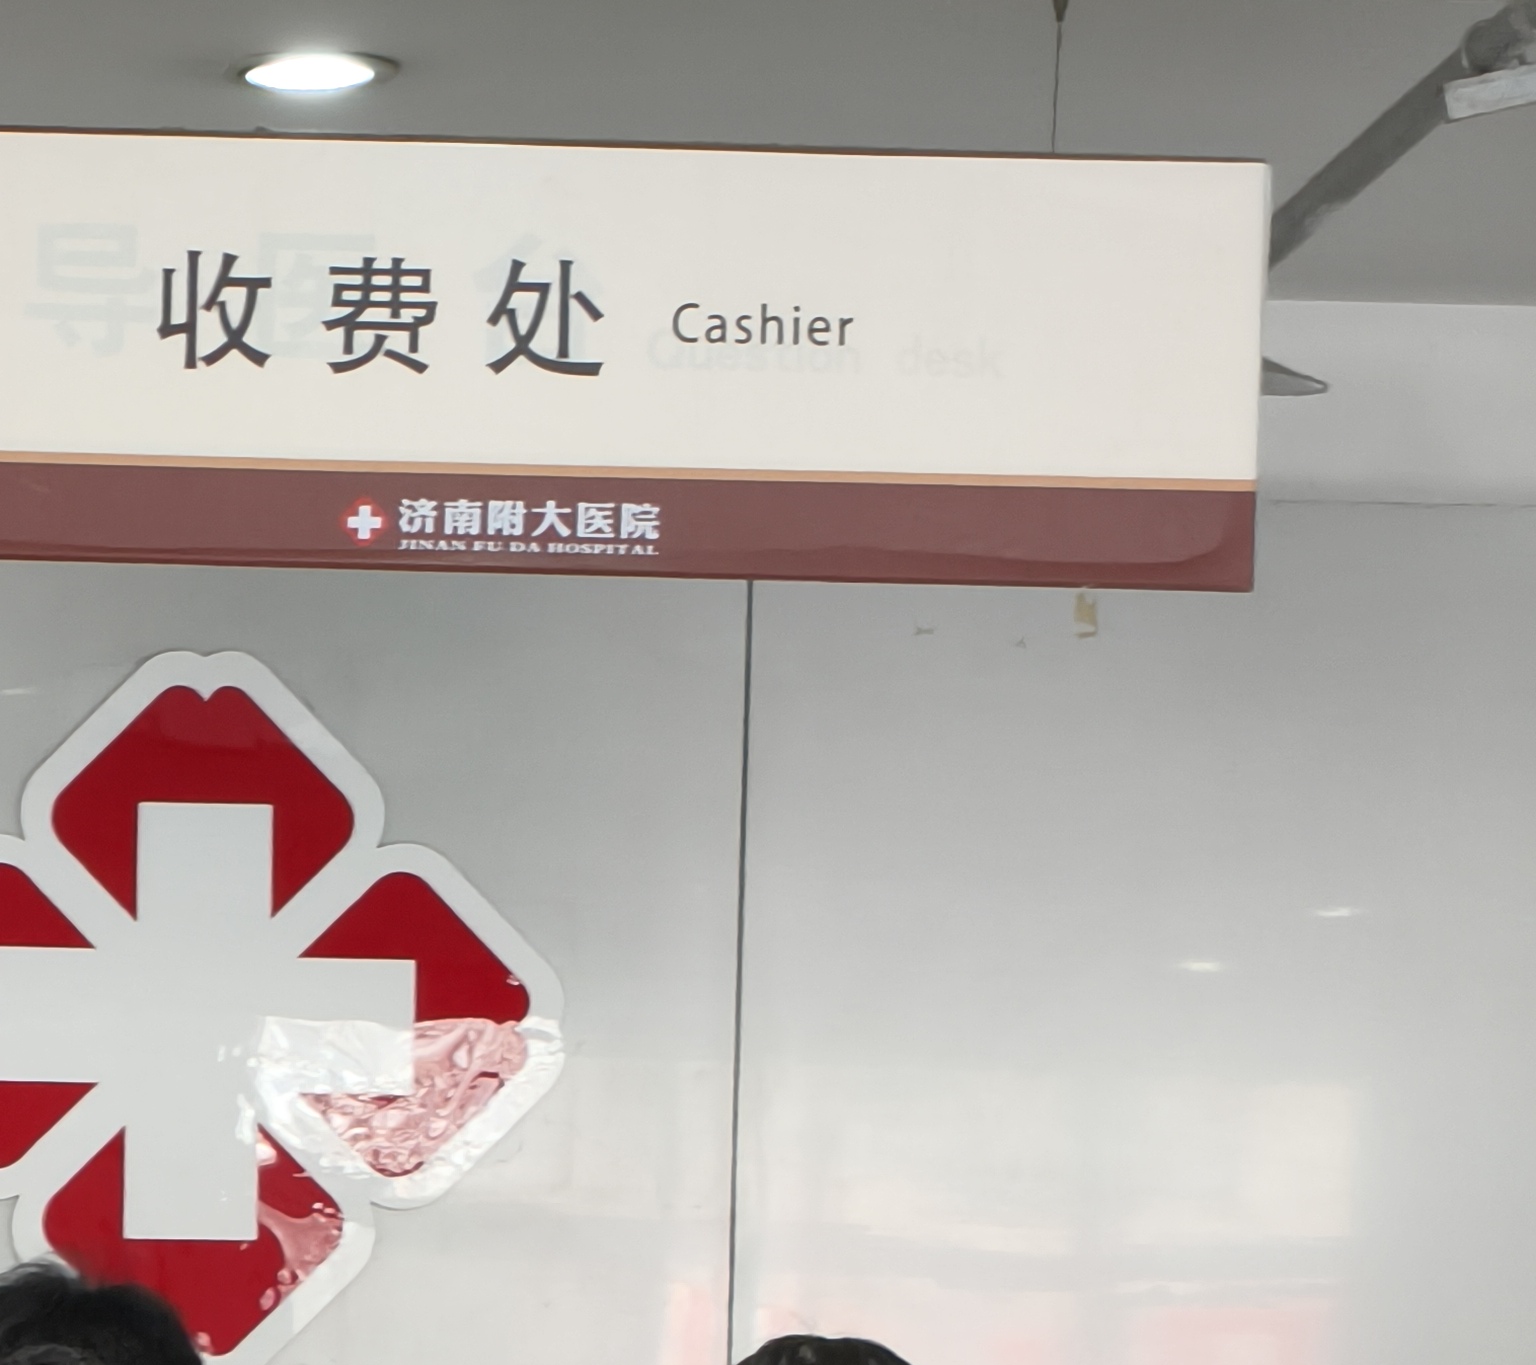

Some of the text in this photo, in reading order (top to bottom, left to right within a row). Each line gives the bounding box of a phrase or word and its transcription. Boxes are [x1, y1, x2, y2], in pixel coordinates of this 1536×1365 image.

[155, 249, 606, 377] 收费处
[670, 302, 855, 347] Cashier
[398, 498, 662, 540] 济南附大医院
[397, 539, 661, 556] JINAN FU DA HOSPITAL
